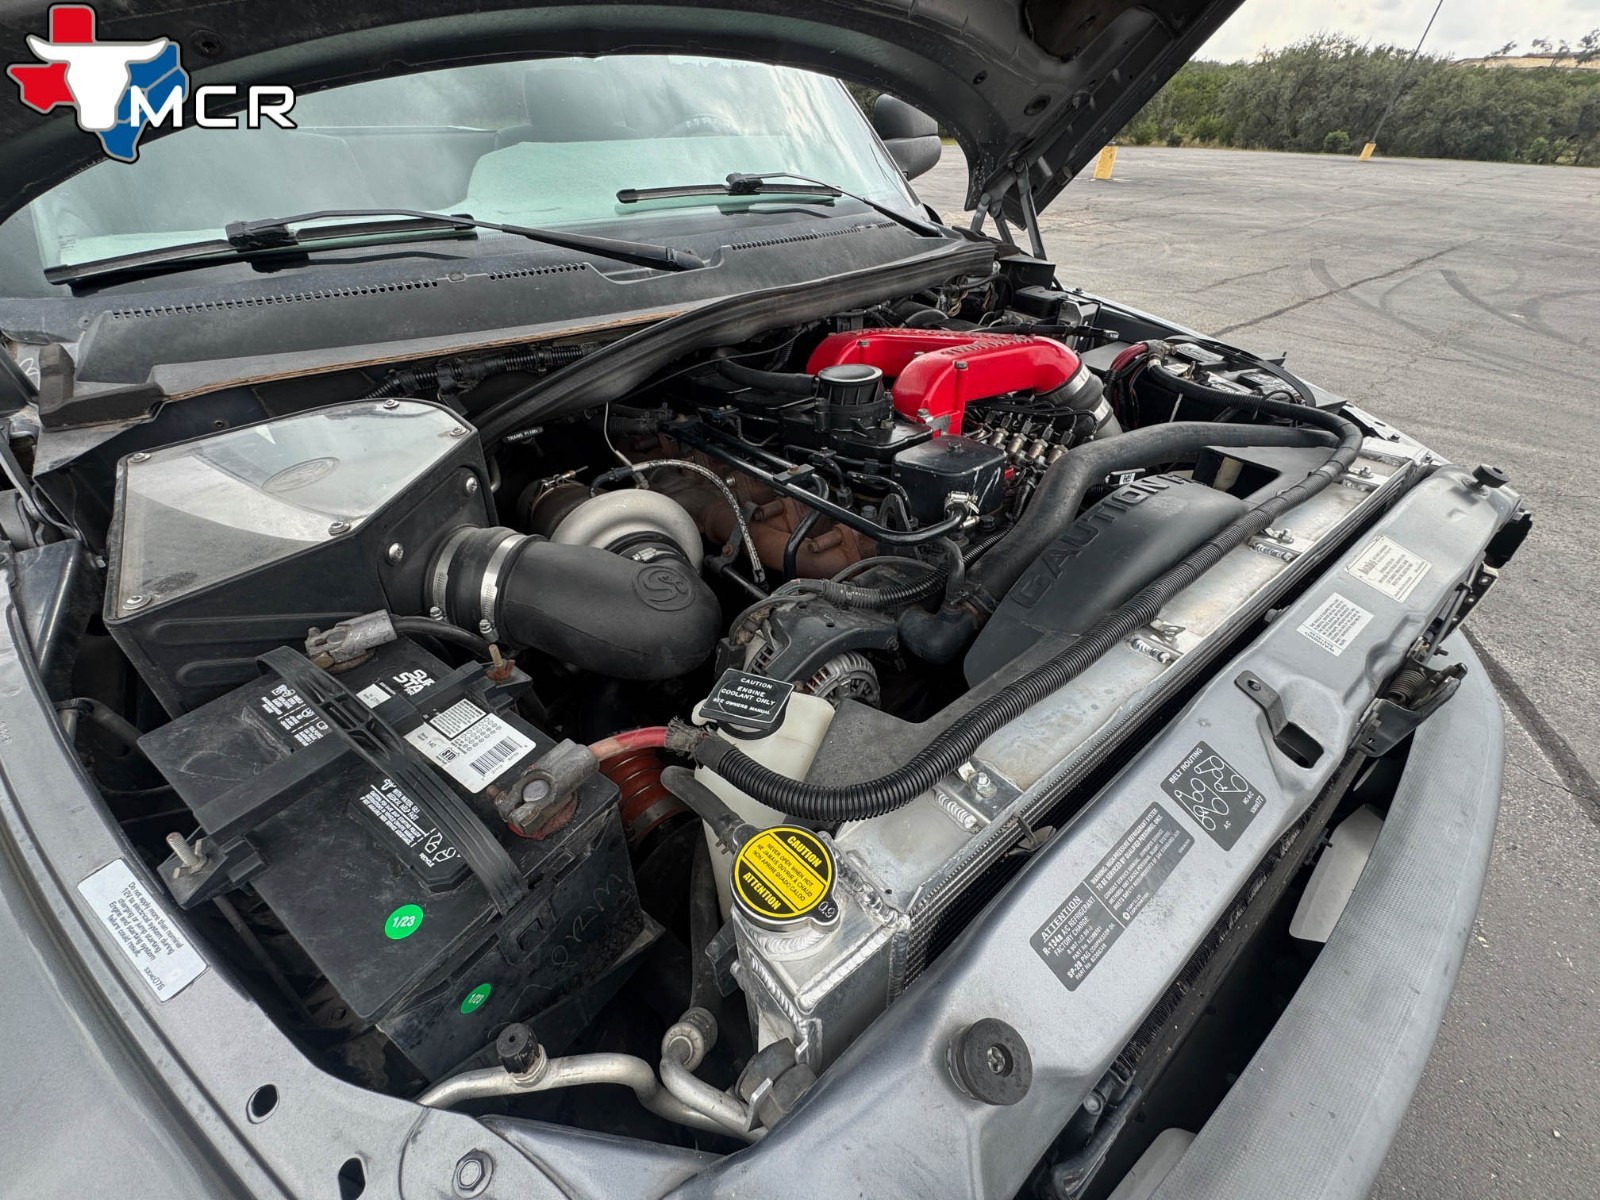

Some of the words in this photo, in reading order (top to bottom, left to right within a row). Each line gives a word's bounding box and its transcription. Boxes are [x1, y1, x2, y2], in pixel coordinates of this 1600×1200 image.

[736, 685, 766, 697] ENGINE
[739, 677, 773, 689] CAUTION
[720, 688, 754, 700] COOLANT
[754, 696, 775, 705] ONLY
[748, 706, 770, 714] MANUAL
[1168, 769, 1182, 784] BELT
[1180, 746, 1203, 771] ROUTING
[786, 834, 822, 868] CAUTION
[762, 849, 779, 865] JAMAIS
[777, 863, 794, 880] OUVRIR
[796, 881, 813, 897] CHAUD
[766, 842, 781, 856] NEVER
[779, 854, 792, 867] OPEN
[790, 865, 804, 879] WHEN
[802, 877, 813, 887] HOT
[752, 849, 763, 860] NON
[789, 885, 806, 901] CALDO
[127, 881, 137, 890] Do
[132, 888, 143, 898] not
[742, 870, 781, 910] ATTENTION
[106, 900, 124, 918] Engine
[137, 895, 152, 910] apply
[119, 914, 130, 926] and
[121, 887, 132, 899] 12V
[132, 901, 151, 923] electrical
[145, 920, 164, 940] system
[158, 936, 175, 955] during
[147, 906, 161, 920] more
[392, 916, 415, 928] 1/23
[1040, 894, 1080, 941] ATTENTION
[106, 913, 122, 930] failure
[117, 927, 131, 942] could
[115, 897, 135, 919] charging
[134, 920, 148, 935] jump
[142, 931, 163, 954] starting
[124, 923, 144, 945] starting
[157, 918, 170, 931] than
[1042, 931, 1063, 956] R-134a
[1067, 895, 1095, 928] REFRIGERANT
[165, 928, 184, 949] nominal
[1053, 932, 1074, 956] FACTORY
[137, 941, 157, 963] system
[1072, 948, 1082, 961] PART
[1080, 949, 1091, 963] PAG
[1075, 967, 1086, 980] PART
